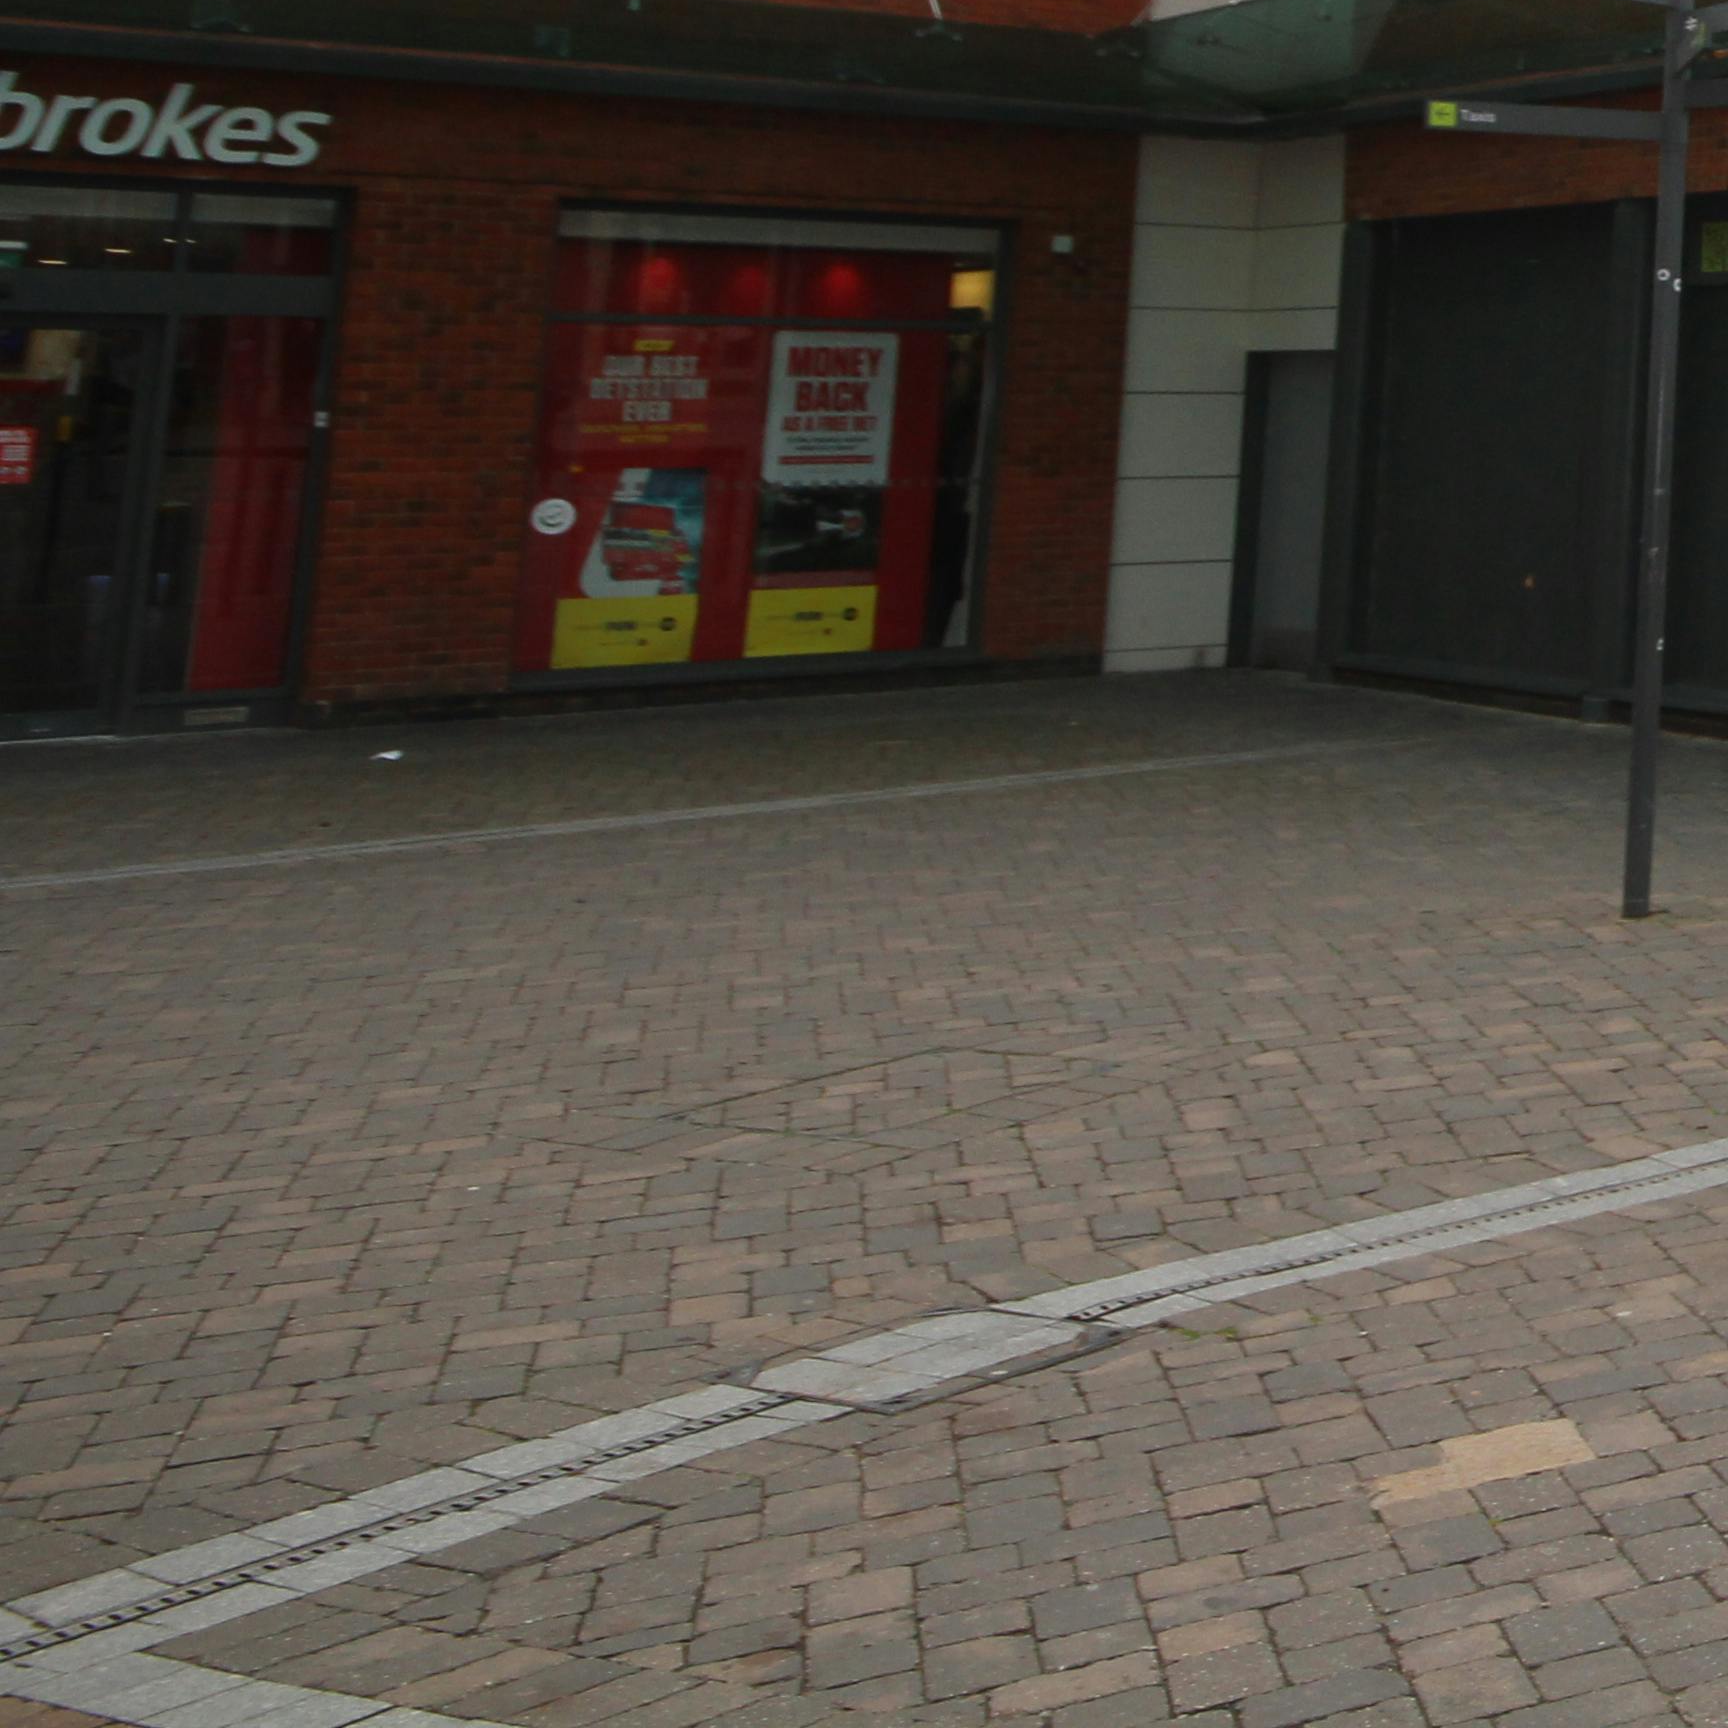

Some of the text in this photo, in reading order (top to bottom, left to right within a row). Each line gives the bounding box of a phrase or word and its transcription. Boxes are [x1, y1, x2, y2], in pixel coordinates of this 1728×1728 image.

[1460, 108, 1497, 123] Taxis
[787, 346, 884, 377] MONEY
[795, 381, 871, 412] BACK
